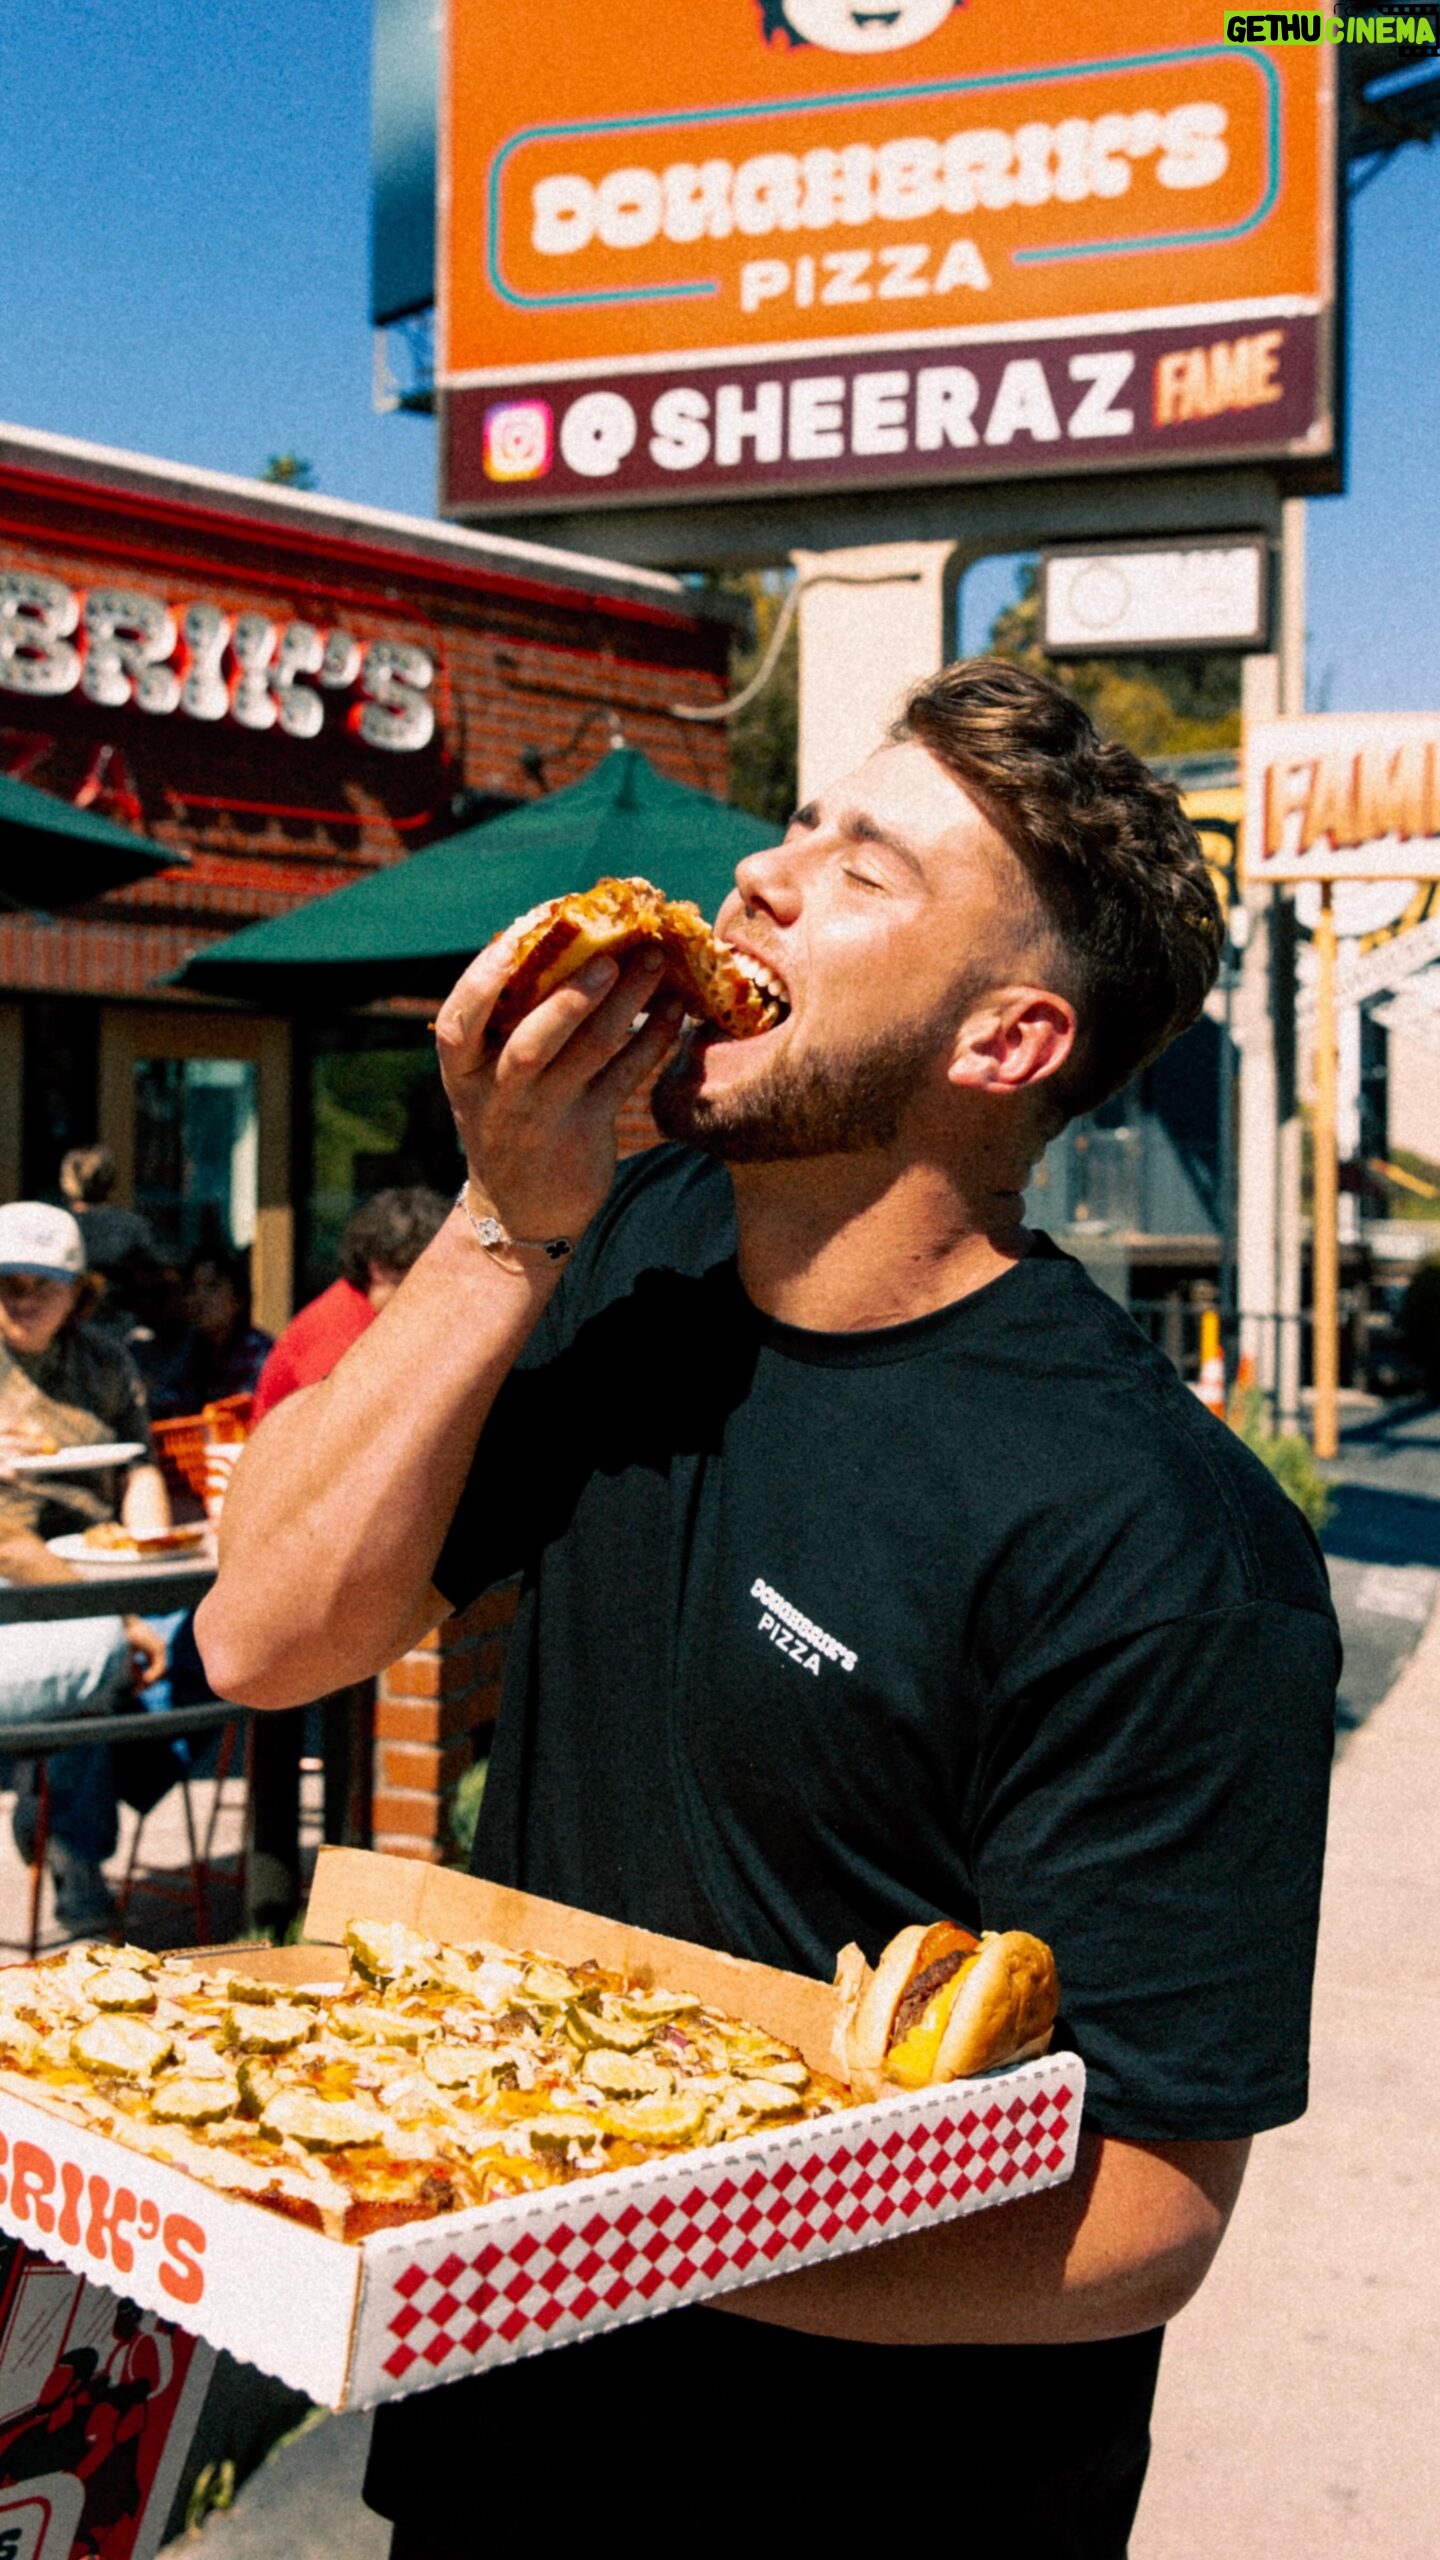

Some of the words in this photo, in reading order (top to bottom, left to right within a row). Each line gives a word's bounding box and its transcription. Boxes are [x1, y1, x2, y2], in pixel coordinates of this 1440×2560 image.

[740, 240, 990, 313] PIZZA
[1153, 328, 1284, 430] FAME
[757, 1612, 820, 1676] PIZZA
[0, 2130, 207, 2304] RIK'S
